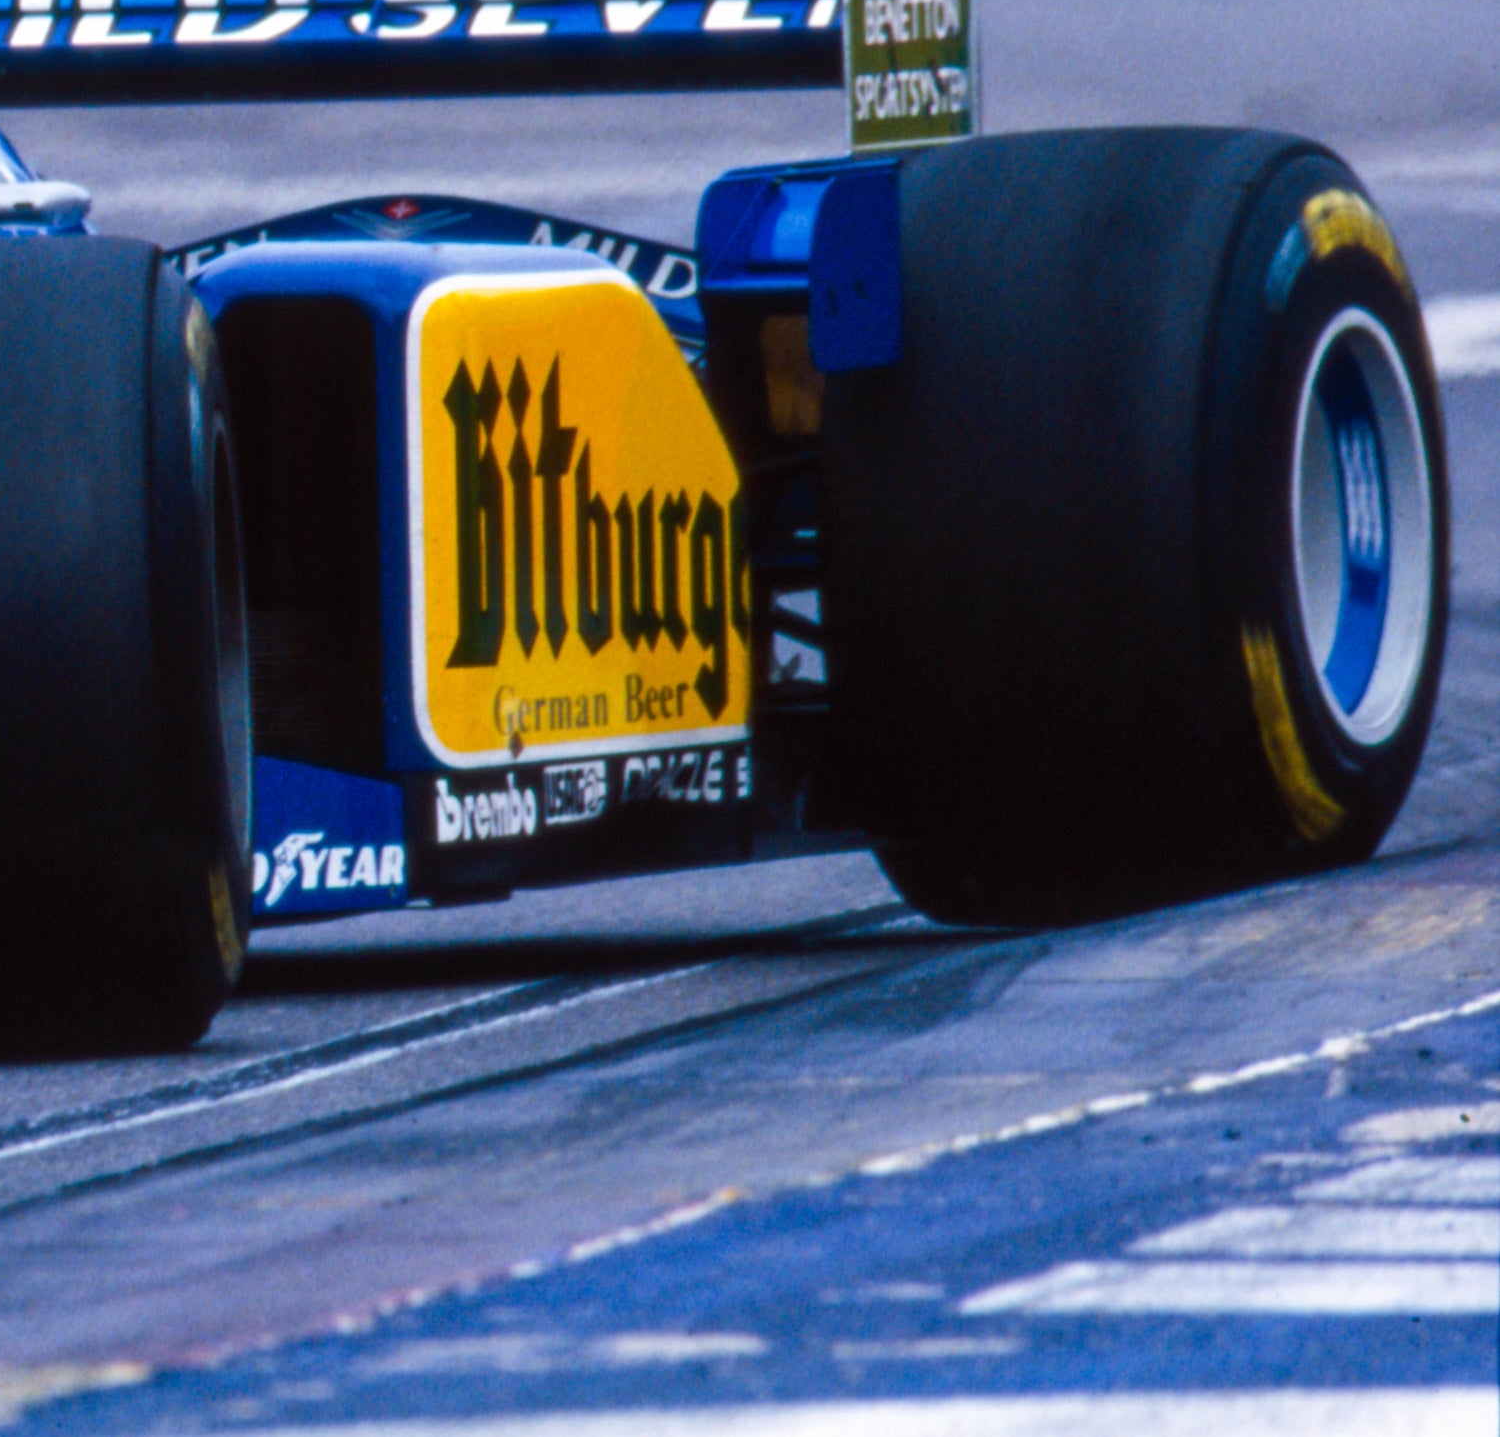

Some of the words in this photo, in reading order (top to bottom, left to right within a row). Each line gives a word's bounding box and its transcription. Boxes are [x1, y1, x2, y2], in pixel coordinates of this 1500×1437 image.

[493, 684, 609, 736] German
[625, 673, 690, 723] Beer
[435, 772, 539, 843] brembo
